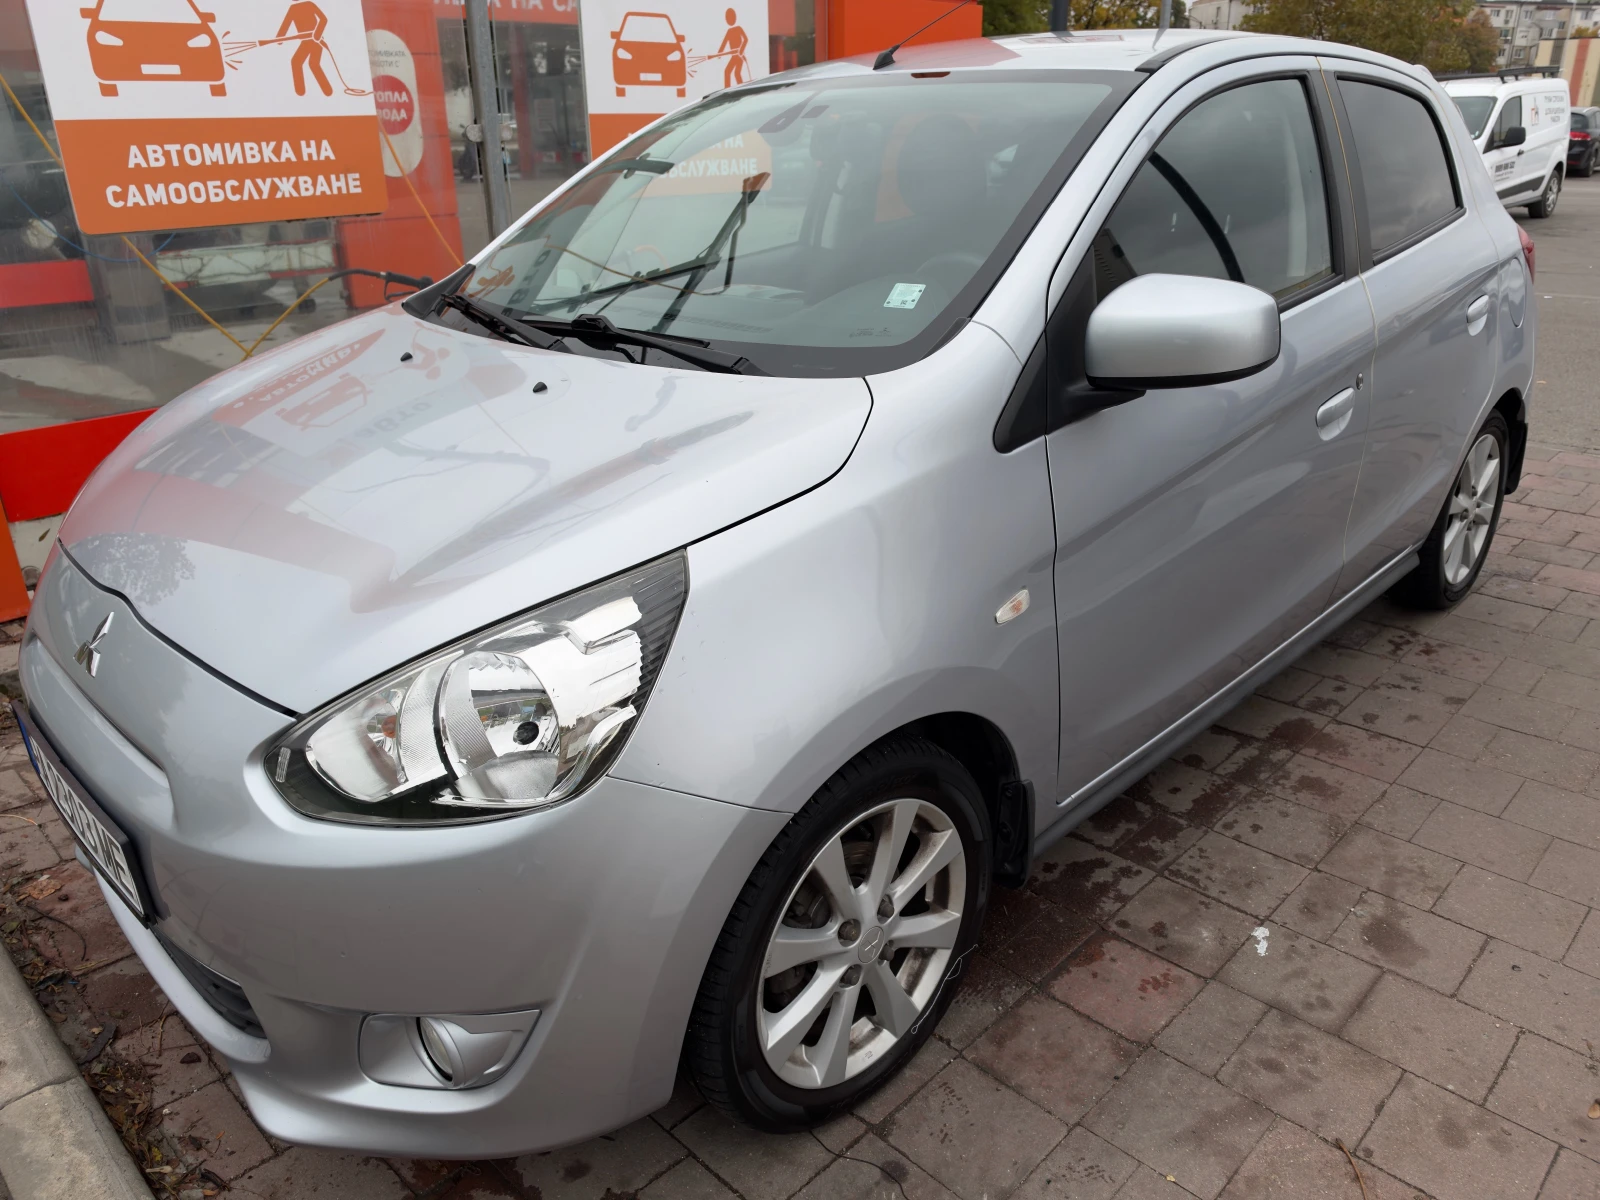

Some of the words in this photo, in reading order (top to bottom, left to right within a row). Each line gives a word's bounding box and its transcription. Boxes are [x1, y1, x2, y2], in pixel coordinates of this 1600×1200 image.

[375, 91, 409, 103] ОПЛА
[128, 141, 298, 169] АВТОМИВКА
[300, 139, 336, 161] НА
[105, 172, 362, 208] САМООБСЛУЖВАНЕ
